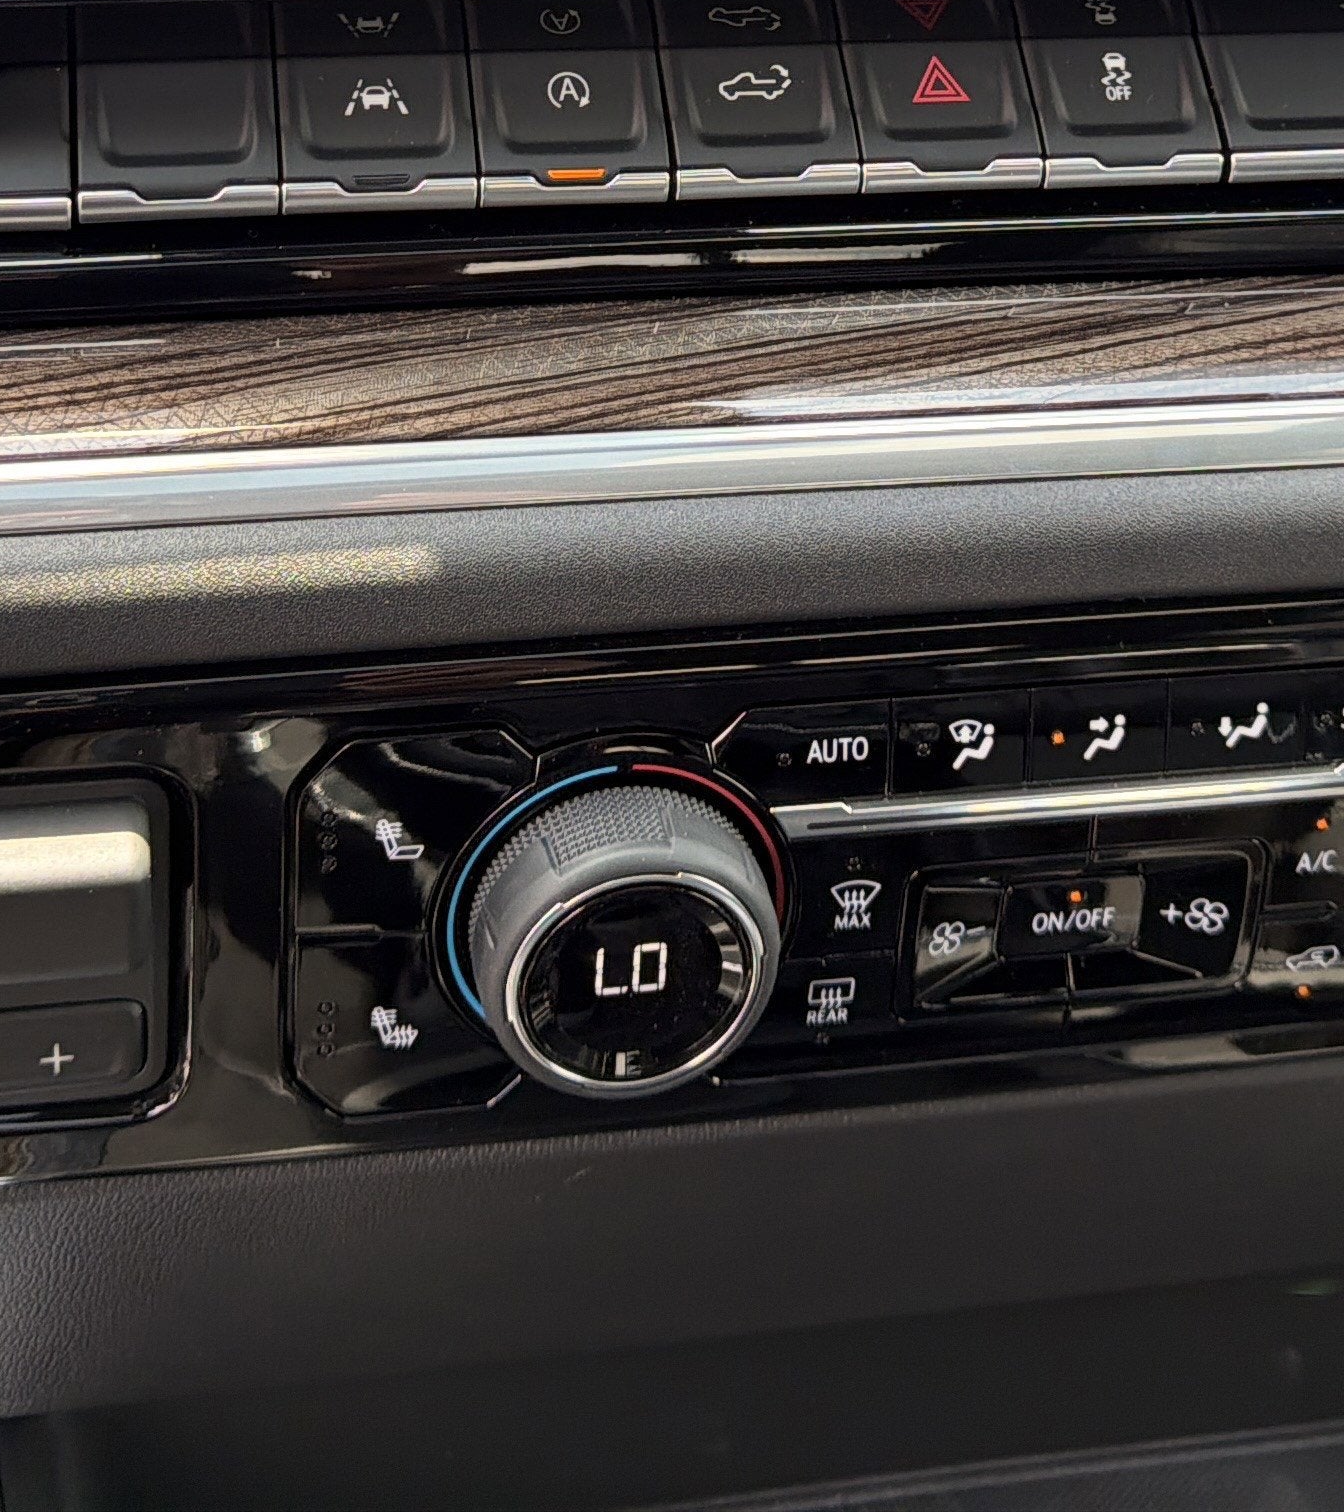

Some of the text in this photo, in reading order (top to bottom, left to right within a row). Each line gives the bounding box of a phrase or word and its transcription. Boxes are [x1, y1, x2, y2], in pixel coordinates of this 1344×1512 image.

[1105, 85, 1133, 101] OFF
[806, 735, 869, 764] AUTO
[1294, 848, 1338, 874] A/C
[833, 911, 872, 931] MAX
[1031, 906, 1116, 935] ON/OFF
[806, 1007, 849, 1026] REAR
